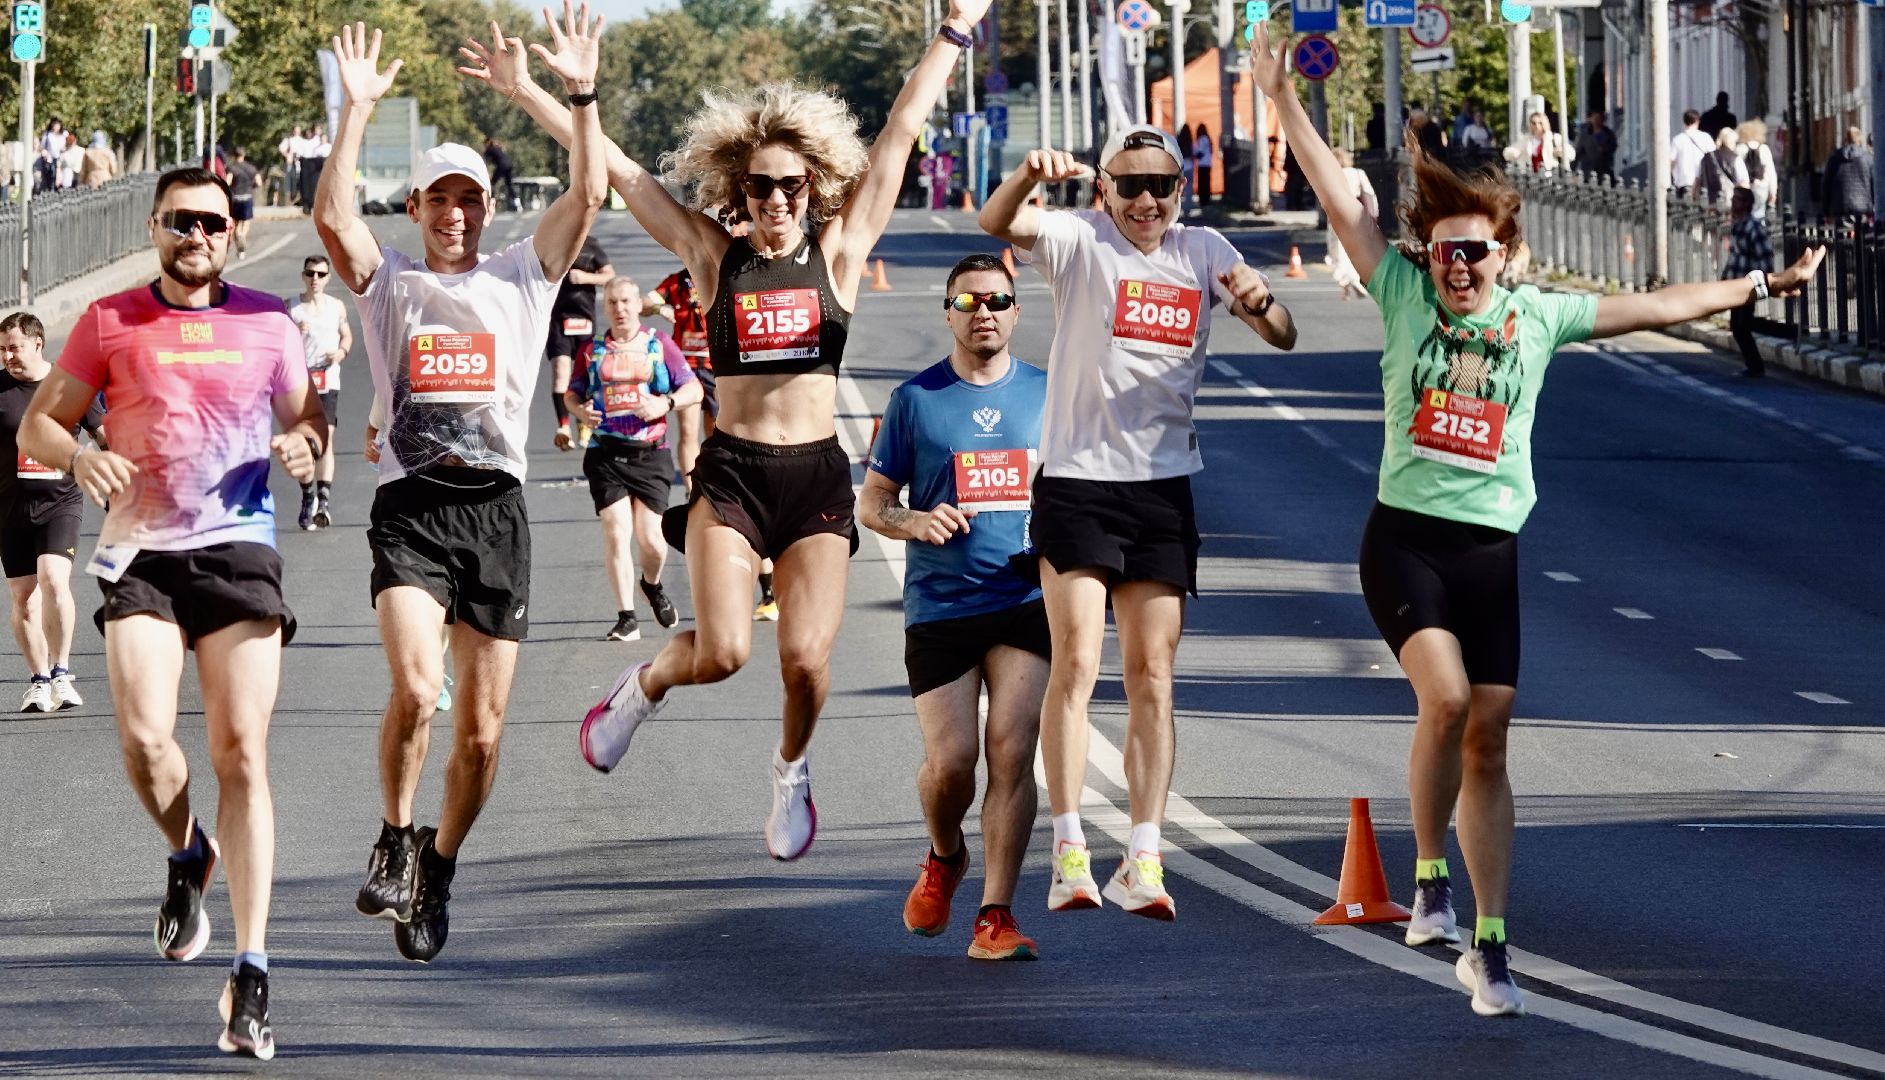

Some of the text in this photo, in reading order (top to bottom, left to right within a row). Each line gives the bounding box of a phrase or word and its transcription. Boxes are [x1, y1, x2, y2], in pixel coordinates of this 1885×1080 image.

[746, 309, 810, 335] 2155
[1125, 300, 1191, 330] 2089
[419, 353, 488, 375] 2059
[608, 392, 638, 405] 2042
[1431, 411, 1490, 444] 2152
[967, 467, 1020, 488] 2105
